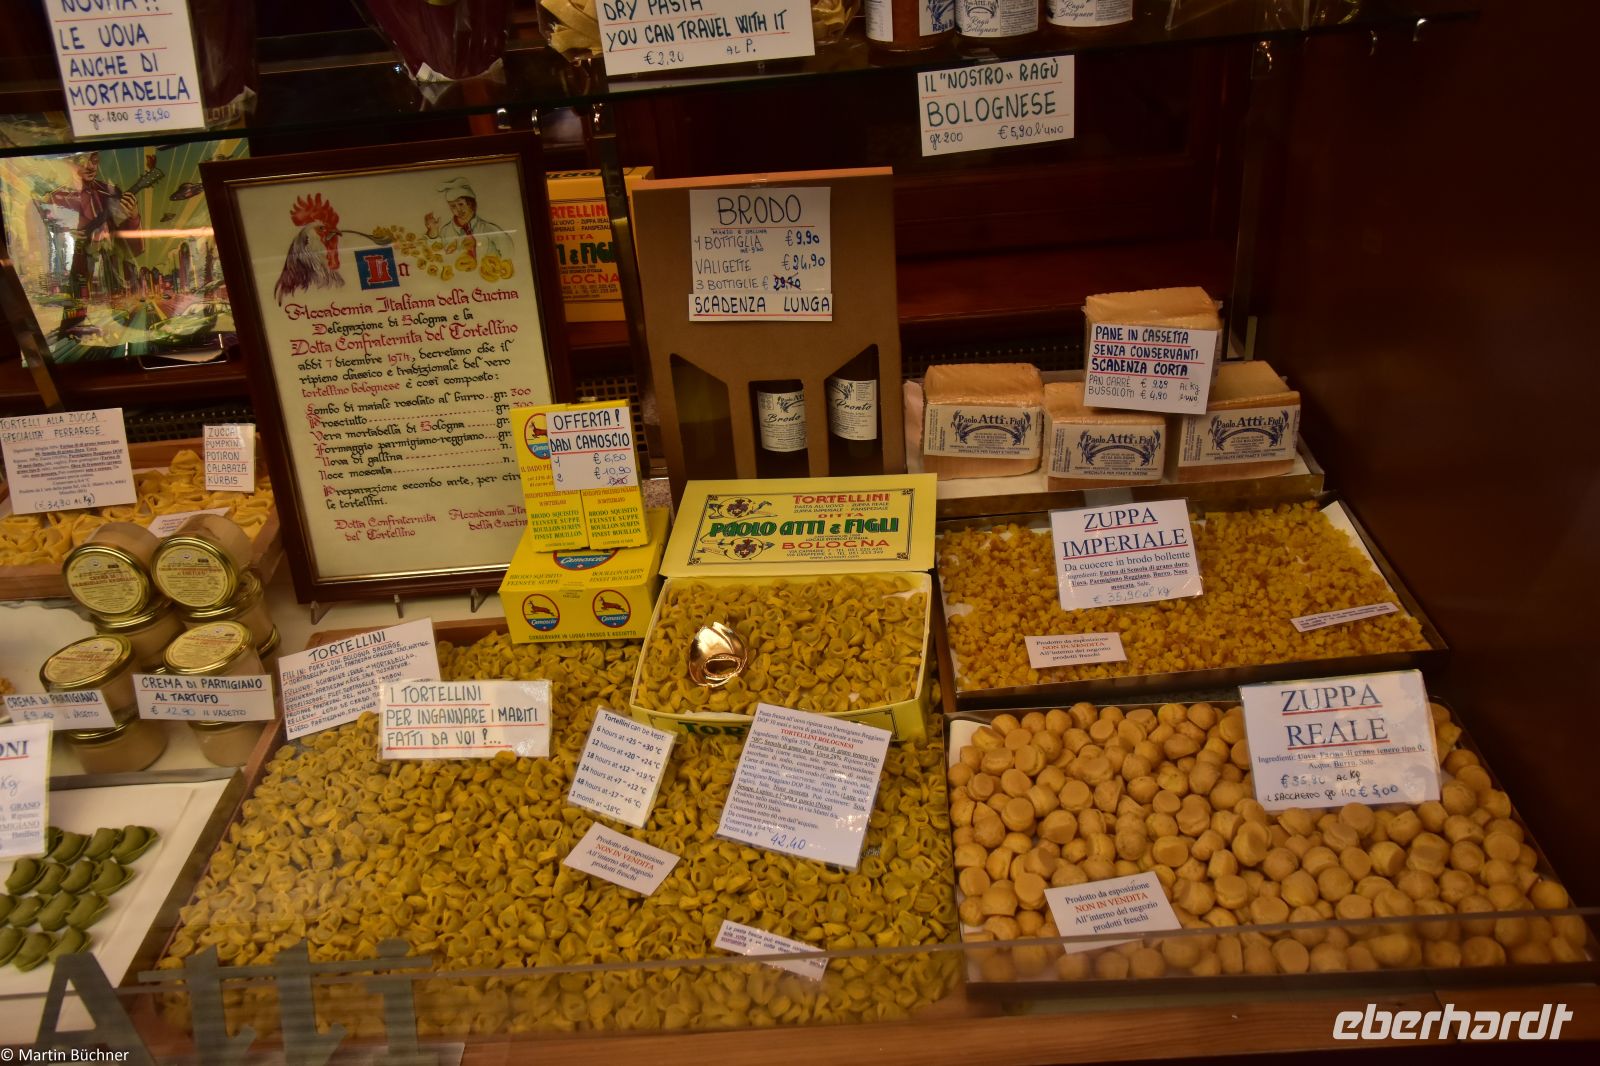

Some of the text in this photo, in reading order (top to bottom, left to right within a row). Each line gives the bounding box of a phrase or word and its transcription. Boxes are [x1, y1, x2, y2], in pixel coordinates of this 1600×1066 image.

[603, 0, 703, 21] DRY PASTA
[60, 23, 149, 50] LE UOVA
[606, 9, 787, 52] YOU CAN TRAVEL WITH IT
[70, 52, 159, 77] ANCHE DI
[924, 59, 1059, 92] IL RAGÙ
[69, 76, 190, 106] MORTADELLA
[926, 90, 1056, 127] BOLOGNESE
[718, 194, 801, 225] BRODO
[704, 235, 762, 250] BOTTIGLIA
[695, 258, 752, 275] VALIGETTE
[696, 278, 759, 291] 3 BOTTIGLIE
[285, 288, 519, 320] Accademia Italiana della Cucina
[695, 295, 830, 313] SCADENZA LUNGA
[312, 320, 383, 337] Delegazione
[389, 314, 398, 327] di
[402, 314, 447, 329] Bologna
[463, 308, 474, 320] la
[290, 319, 519, 356] Dotta Confraternita del Tortellino
[1095, 326, 1189, 344] PANE IN CASSETTA
[335, 346, 472, 368] dicembre decretano
[1093, 343, 1199, 361] SENZA CONSERVANTI
[343, 357, 511, 380] classico tradizionale vero
[1091, 358, 1188, 376] SCADENZA CORTA
[302, 380, 400, 398] tortellino bolognese
[1088, 374, 1103, 386] PAN
[358, 388, 532, 411] maiale rosolato 300
[835, 398, 872, 411] Pronto
[0, 412, 97, 430] TORTELLI ALLA ZUCCA
[307, 411, 368, 428] Prosciutto
[553, 410, 611, 430] OFFERTA
[764, 413, 801, 423] Brodo
[958, 414, 978, 425] Paolo
[978, 413, 1005, 425] Atti
[1236, 415, 1264, 428] Atti
[347, 423, 401, 438] mortadella
[1085, 434, 1105, 445] Paolo
[1106, 433, 1134, 444] Atti
[206, 440, 239, 448] PUMPKIN
[314, 441, 373, 457] Formaggio
[549, 433, 630, 453] DADI CAMOSCIO
[206, 451, 240, 461] POTIRON
[367, 452, 403, 467] gallina
[792, 493, 890, 505] TORTELLINI
[709, 517, 899, 537] PAOLO ATTI FIGLI
[1083, 507, 1158, 529] ZUPPA
[781, 540, 890, 550] BOLOGNA
[1063, 528, 1188, 557] IMPERIALE
[1064, 551, 1191, 572] Da cuocere in brodo bollente
[308, 631, 386, 662] TORTELLINI
[141, 676, 182, 689] CREMA
[201, 677, 262, 690] PARMIGIANO
[7, 691, 98, 709] CREMA PARMIGIANO
[155, 692, 218, 704] AL TARTUFO
[401, 685, 482, 703] TORTELLINI
[1281, 683, 1382, 712] ZUPPA
[386, 707, 538, 727] PER INGANNARE MARITI
[604, 713, 631, 729] Tortellini
[387, 730, 475, 747] FATTI DA VOI
[601, 726, 617, 738] hours
[780, 728, 854, 750] TORTELLINI BOLOGNESI
[1284, 718, 1389, 746] REALE
[599, 740, 616, 753] hours
[596, 834, 665, 866] Prodotto esposizione
[596, 843, 656, 871] NON IN VENDITA
[591, 860, 637, 882] prodotti freschi
[1064, 882, 1150, 905] Prodotto da esposizione
[1074, 892, 1149, 913] NON IN VENDITA
[1117, 908, 1128, 917] del
[1129, 902, 1158, 915] negozio
[1093, 912, 1149, 933] prodotti freschi
